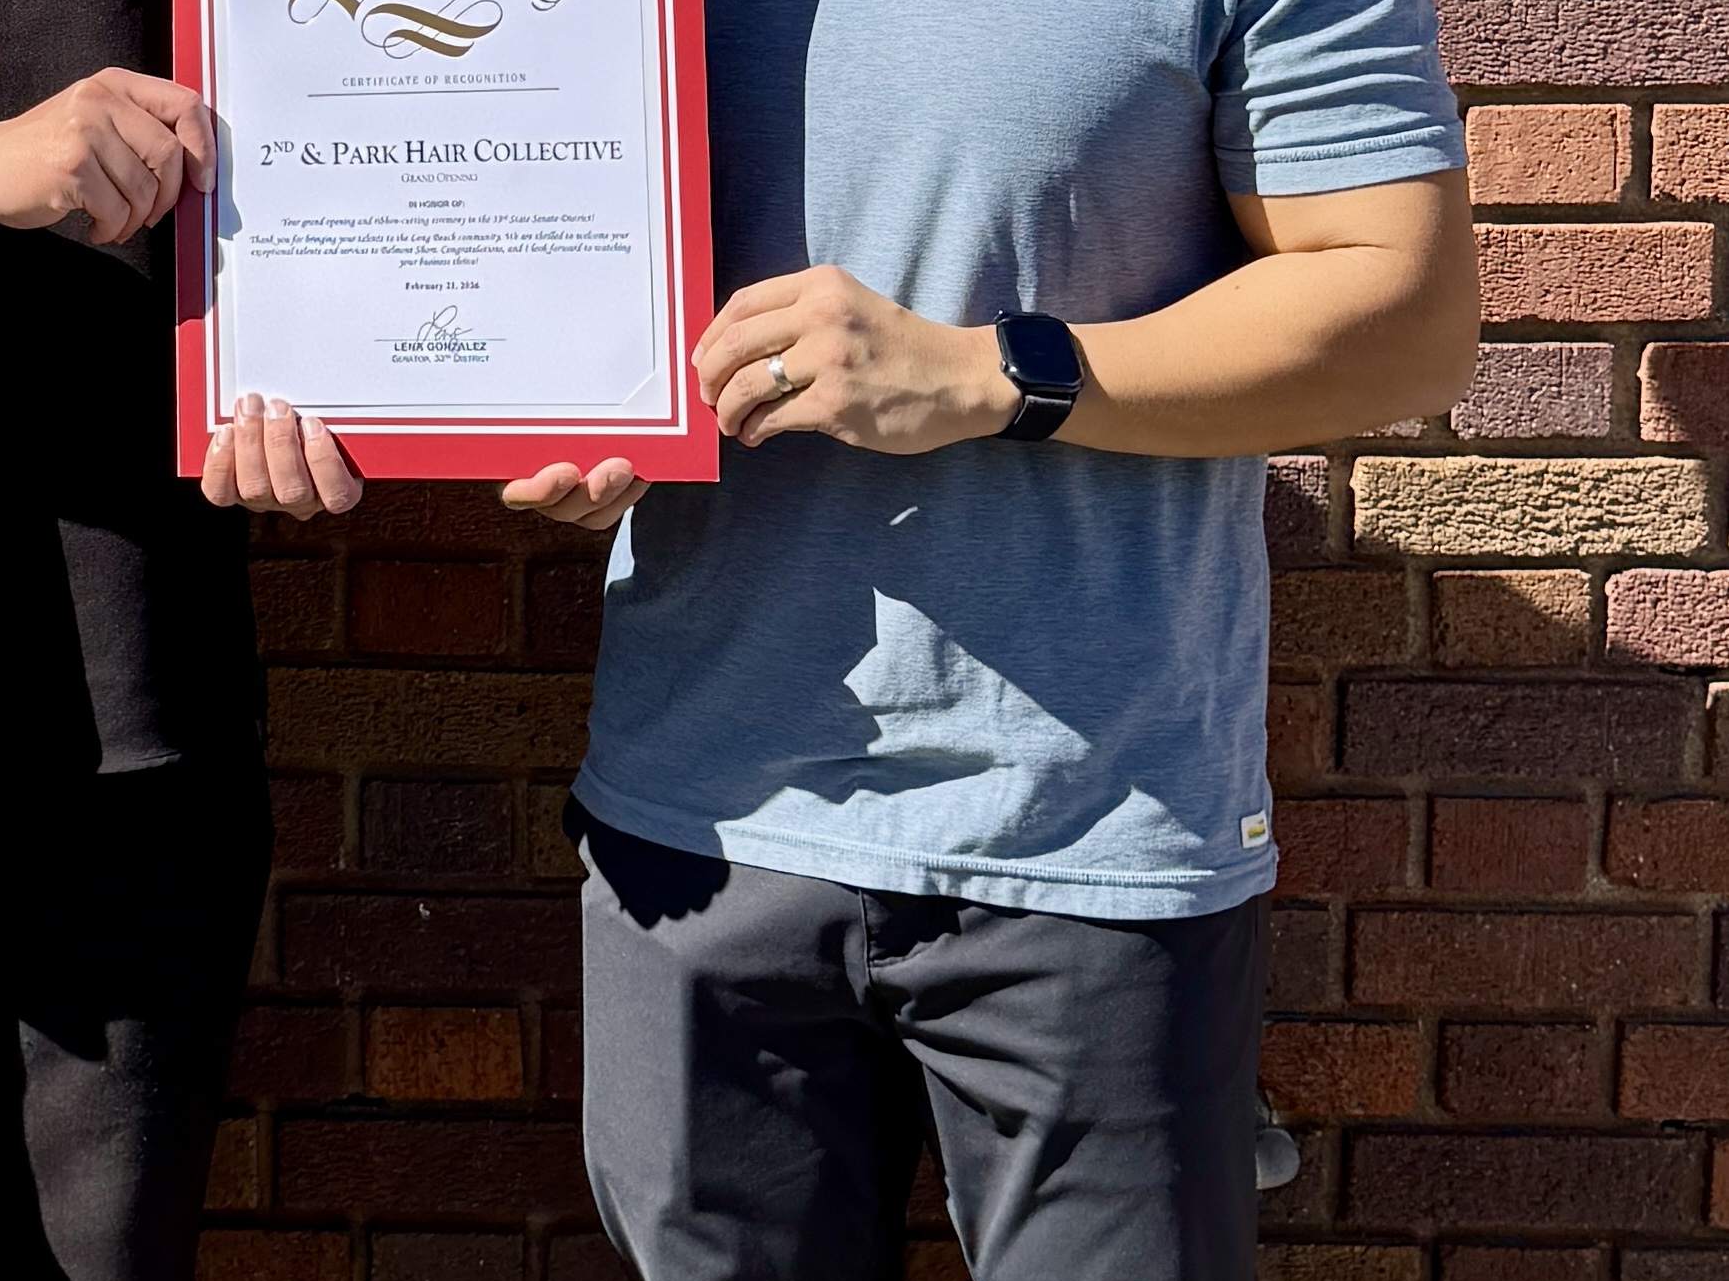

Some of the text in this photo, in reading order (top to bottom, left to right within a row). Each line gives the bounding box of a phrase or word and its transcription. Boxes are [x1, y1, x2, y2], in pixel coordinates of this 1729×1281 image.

[342, 73, 527, 87] CERTIFICATE OF RECOGNITION
[301, 142, 326, 166] &
[331, 141, 399, 165] PARK
[405, 140, 469, 164] HAIR
[474, 138, 623, 162] COLLECTIVE
[393, 341, 487, 352] LENA GONZALEZ
